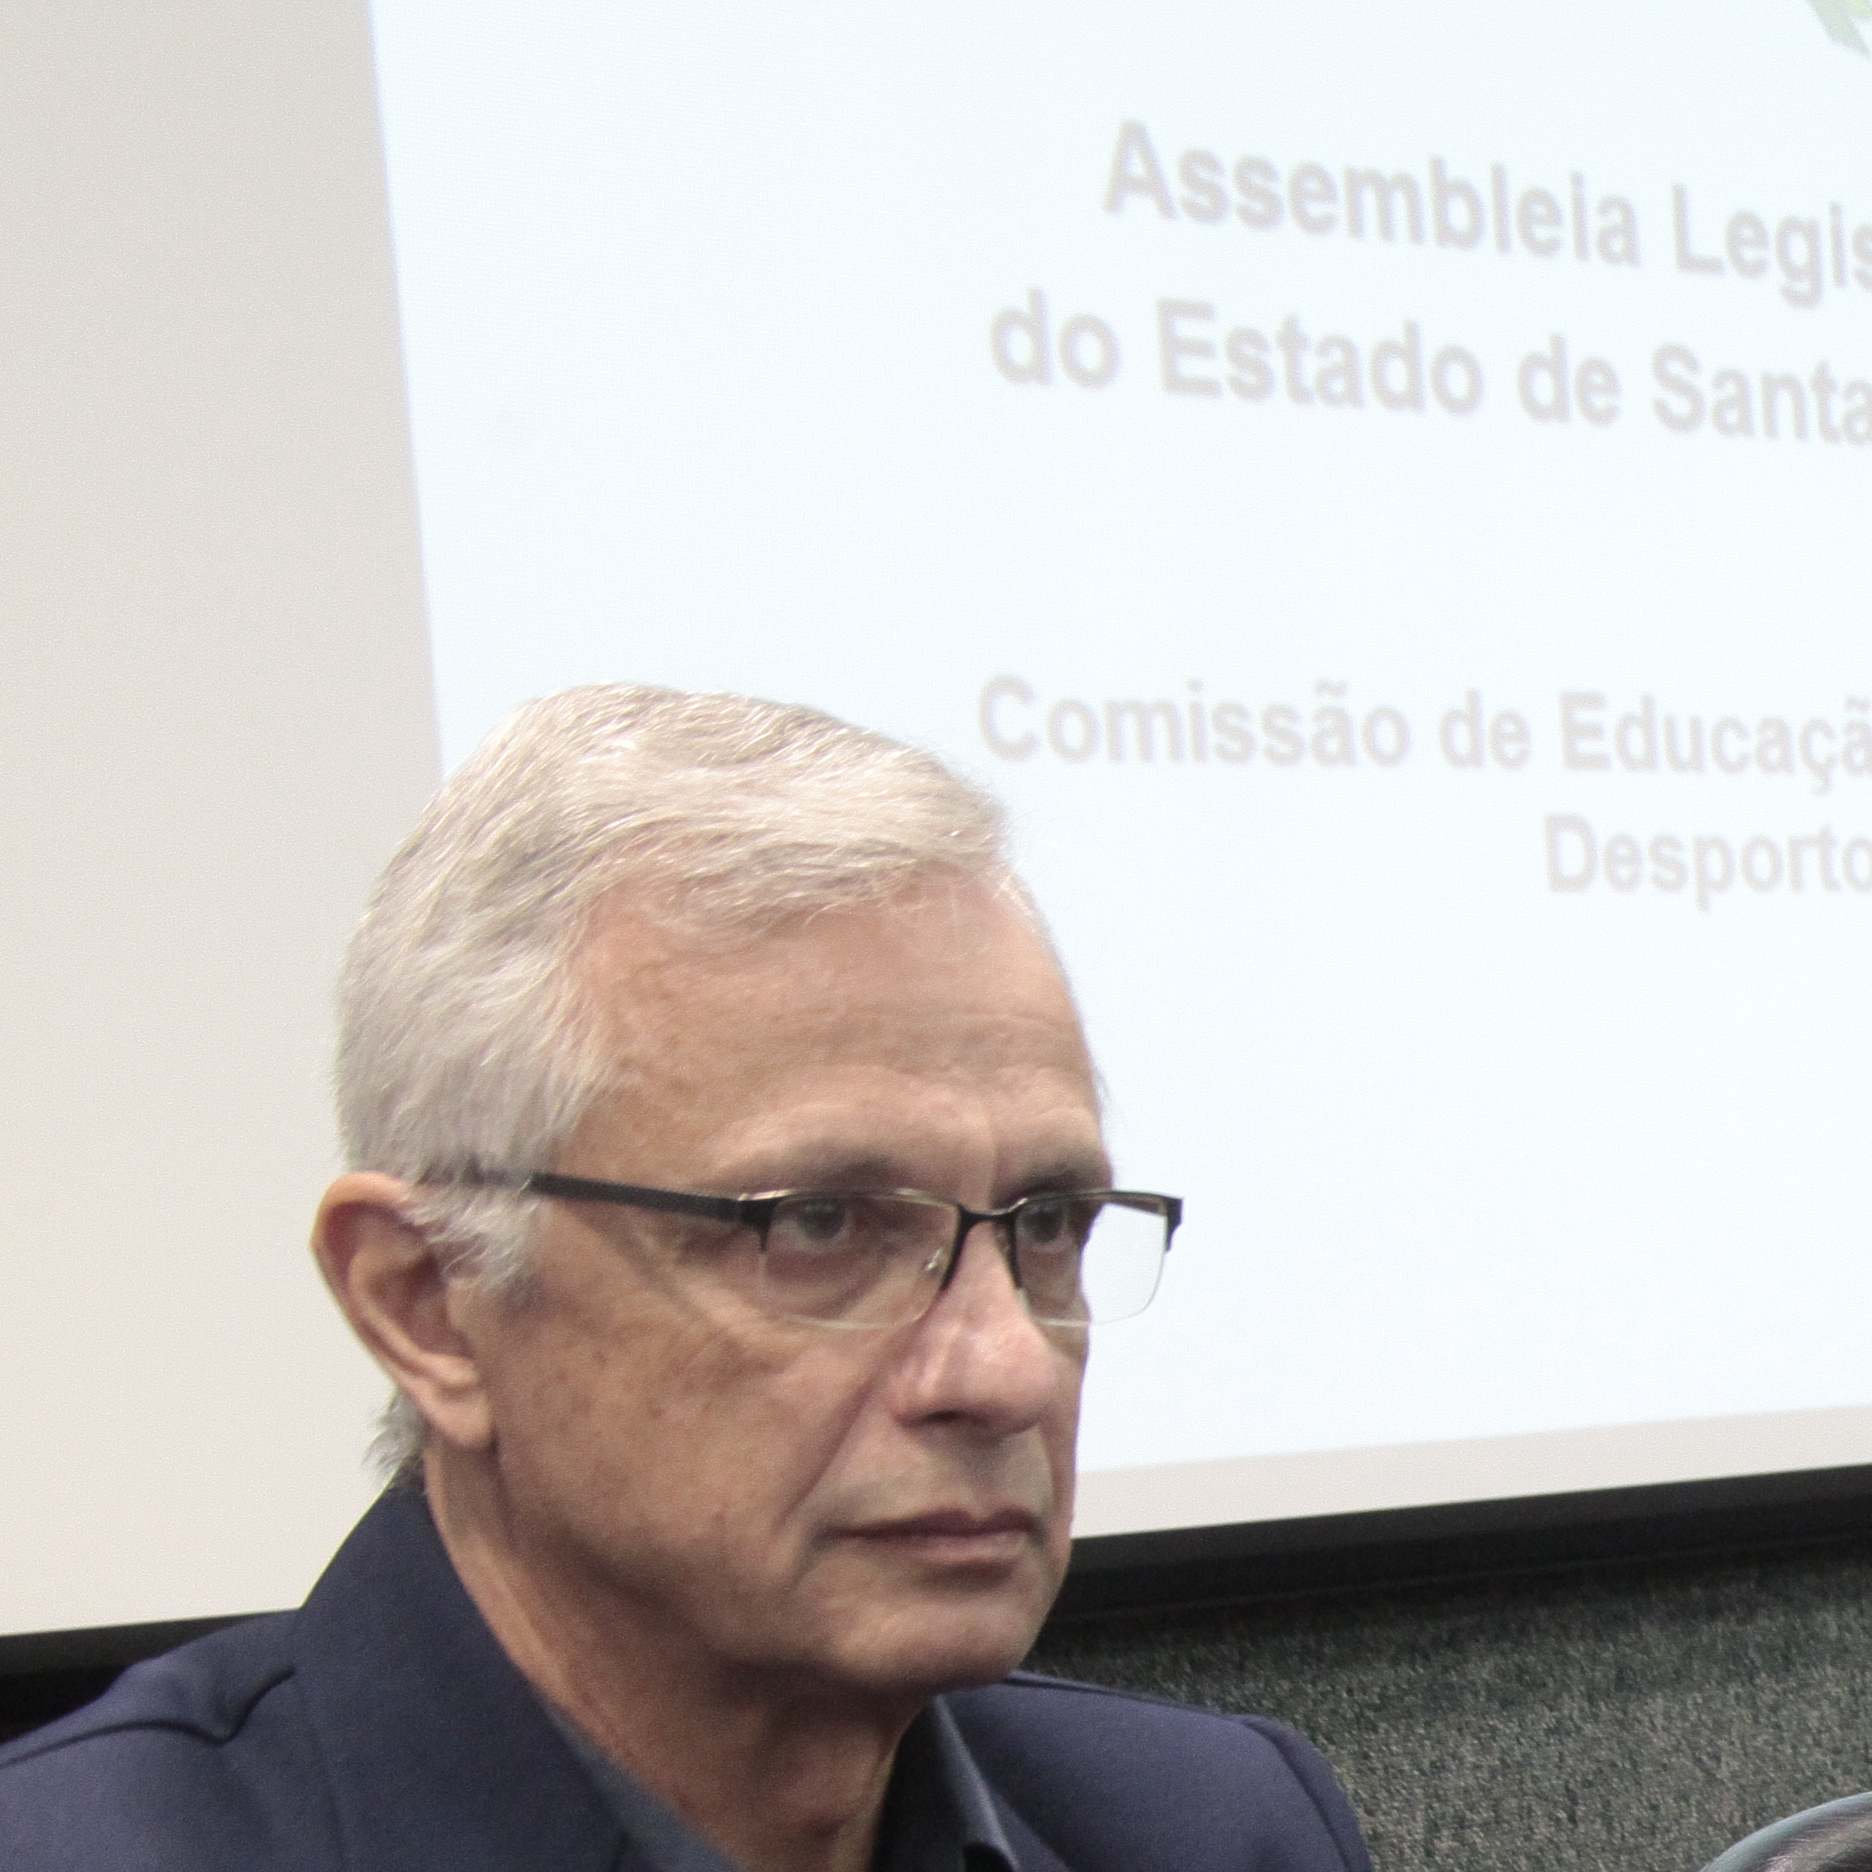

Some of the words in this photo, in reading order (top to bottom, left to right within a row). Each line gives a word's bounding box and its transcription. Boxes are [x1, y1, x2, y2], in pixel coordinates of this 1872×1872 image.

[1104, 117, 1642, 268] Assembleia
[990, 289, 1121, 388] do
[1155, 298, 1484, 416] Estado
[1517, 336, 1621, 425] de
[977, 675, 1412, 769] Comissão
[1439, 689, 1531, 771] de
